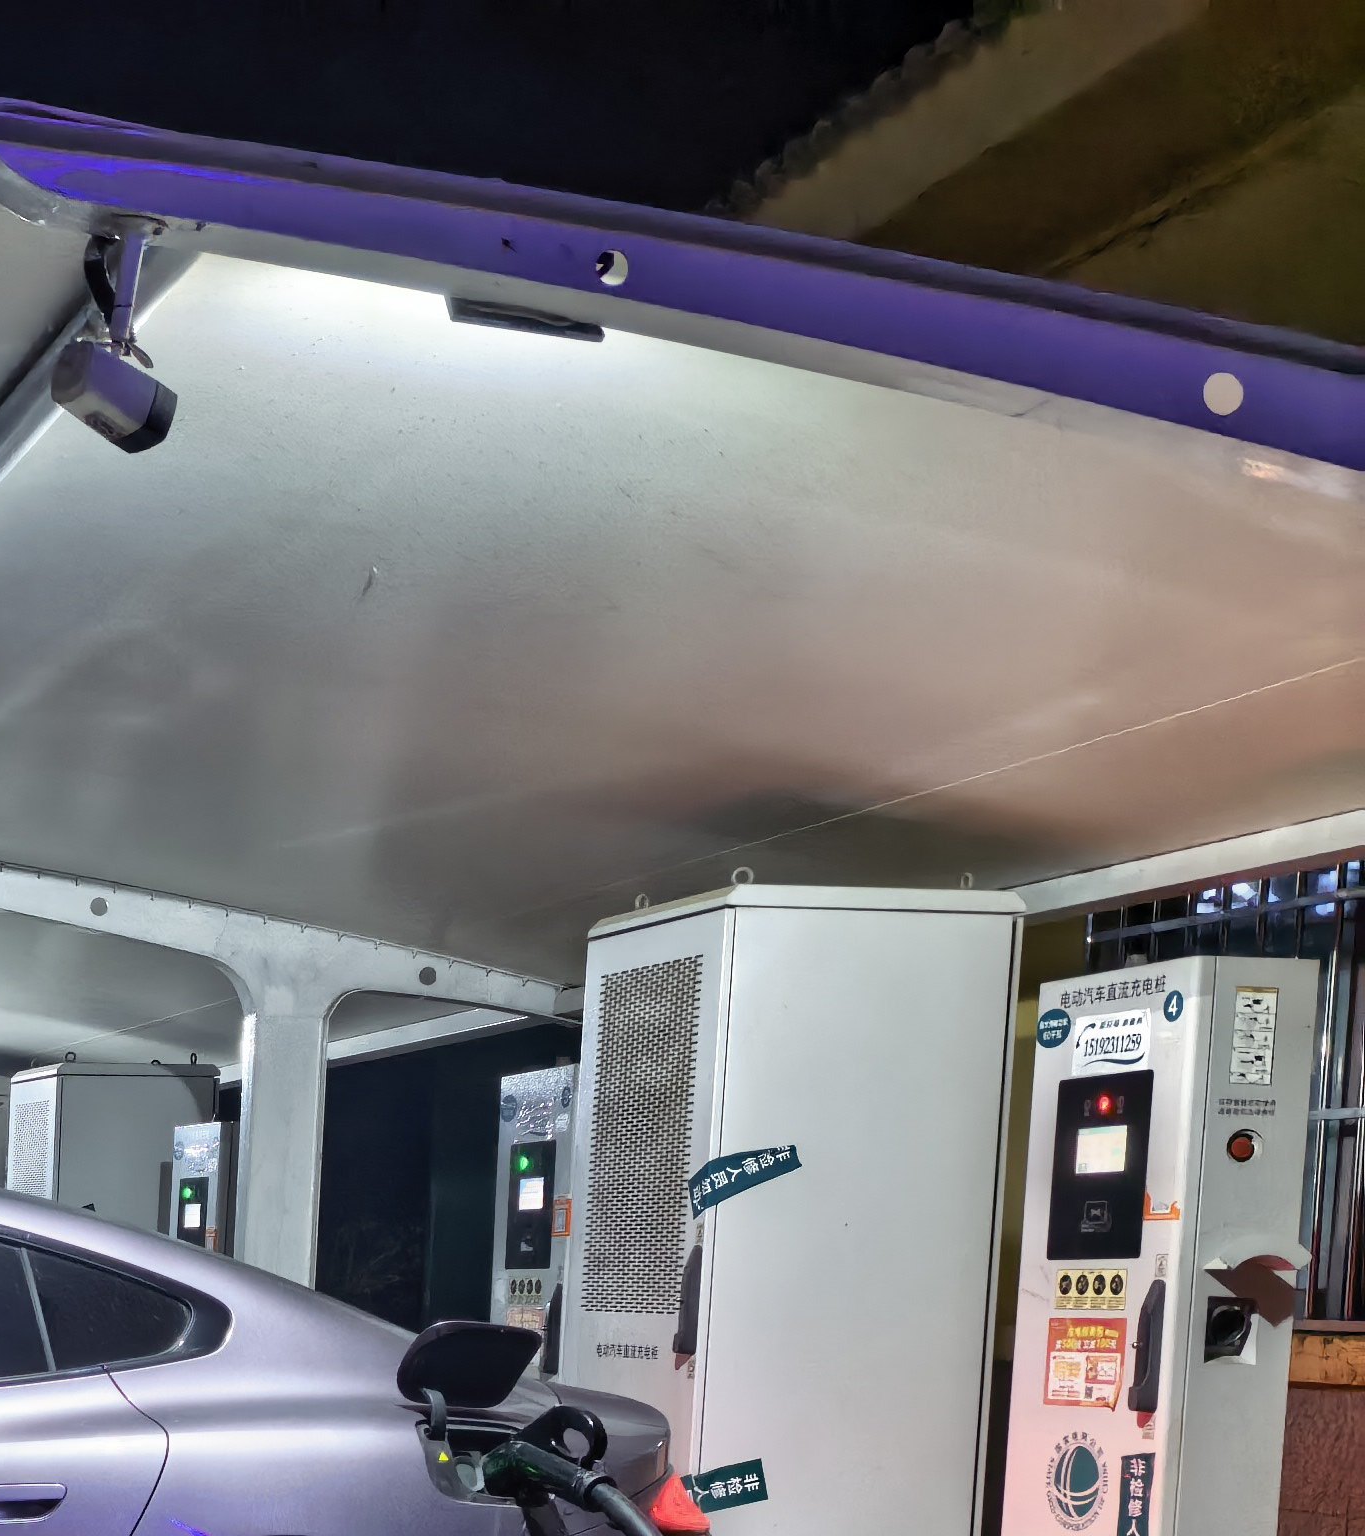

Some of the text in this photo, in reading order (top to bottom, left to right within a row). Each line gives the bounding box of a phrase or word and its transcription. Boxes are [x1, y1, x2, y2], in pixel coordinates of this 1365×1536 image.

[1059, 974, 1167, 1009] 电动汽车直流充电桩
[1083, 1033, 1143, 1057] 15192311259
[687, 1472, 761, 1504] 非检修人
